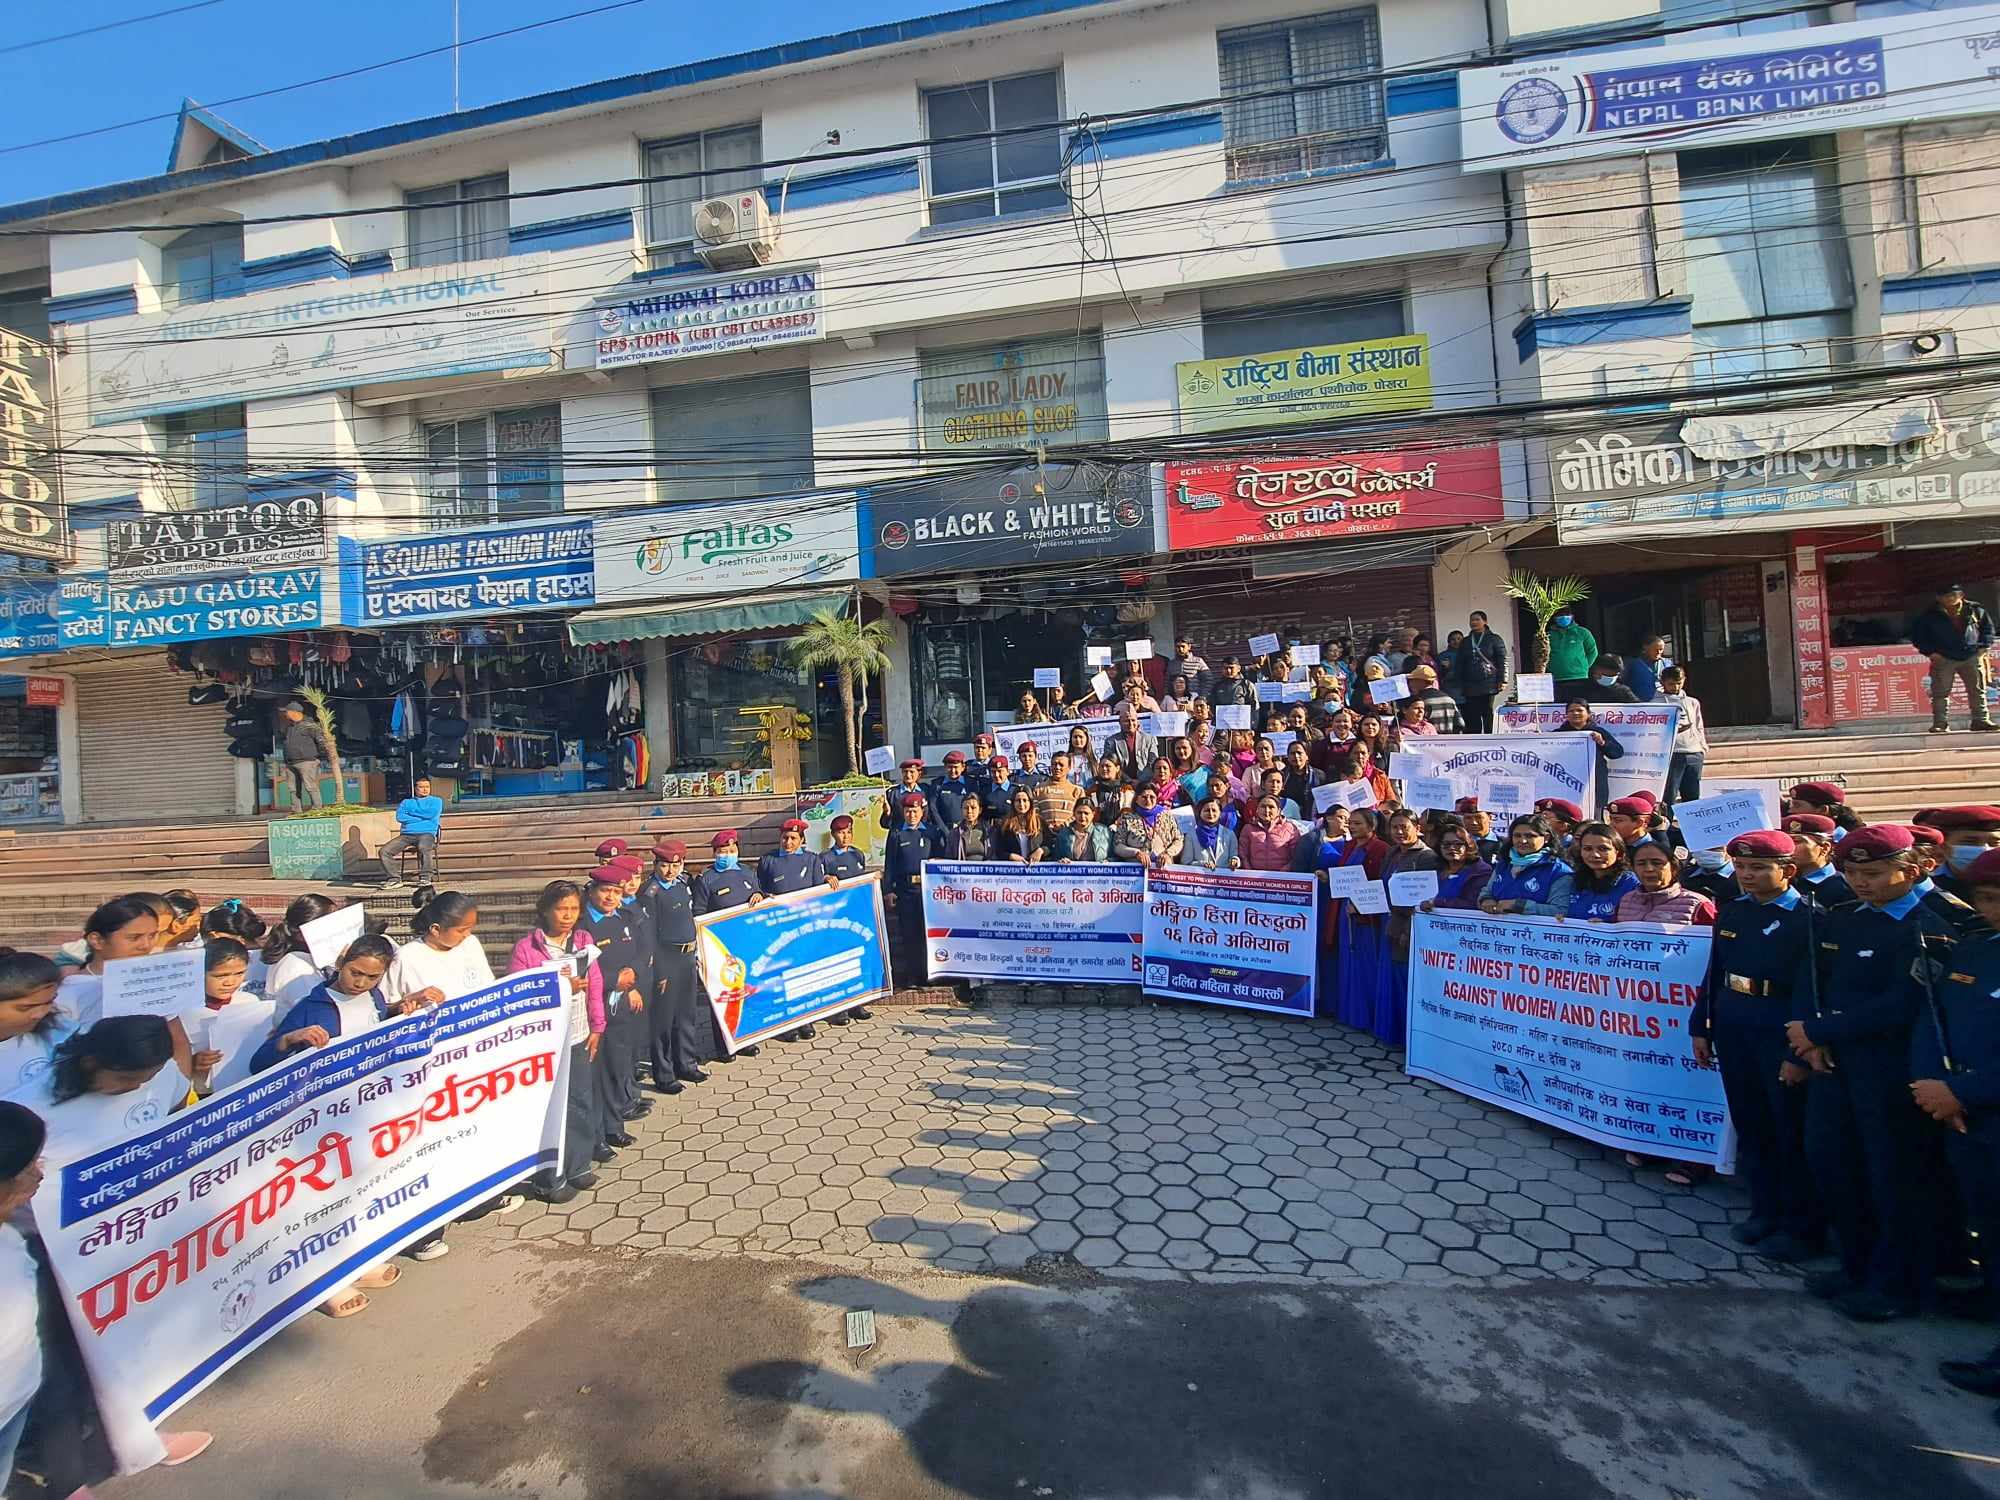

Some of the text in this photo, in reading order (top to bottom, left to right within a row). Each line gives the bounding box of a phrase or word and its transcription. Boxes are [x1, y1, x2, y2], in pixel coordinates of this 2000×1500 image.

[1605, 104, 1684, 128] NEPAL
[1697, 94, 1764, 118] BANK
[1776, 81, 1881, 108] LIMITED
[274, 271, 505, 322] INTERNATIONAL
[629, 273, 816, 317] NATIONAL KOREAN
[629, 295, 817, 333] LANGUAGE INSTITUTE
[751, 312, 816, 332] CLASSES)
[649, 343, 714, 360] RAJEEV GURUNG
[1222, 344, 1422, 390] राष्ट्रिय बीमा संस्थान
[954, 372, 1067, 409] FAIR LADY
[943, 404, 1077, 444] CLOTHING SHOP
[119, 497, 318, 549] TATTOO
[914, 499, 1111, 541] BLACK & WHITE
[1023, 524, 1112, 541] FASHION WORLD
[1266, 499, 1401, 531] सुन पसल
[142, 533, 283, 565] SUPPLIES
[366, 530, 546, 578] A SQUARE FASHION
[718, 557, 743, 569] Fresh
[745, 554, 769, 566] Fruit
[770, 551, 788, 563] and
[789, 549, 814, 563] Juice
[112, 571, 320, 614] RAJU GAURAV
[366, 592, 383, 618] ए
[63, 614, 105, 639] स्टोर्स
[114, 600, 319, 641] FANCY STORES
[1442, 746, 1506, 774] अधिकारको
[1511, 750, 1541, 770] लागि
[1543, 760, 1584, 794] महिला
[281, 822, 335, 839] SQUARE
[961, 865, 983, 874] INVEST
[985, 865, 995, 874] TO
[995, 865, 1024, 874] PREVENT
[1025, 866, 1057, 875] VIOLENCE
[1058, 866, 1086, 875] AGAINST
[1087, 866, 1114, 875] WOMEN
[971, 886, 998, 905] हिंसा
[1050, 890, 1067, 906] १६
[1071, 888, 1095, 905] दिने
[1203, 904, 1240, 926] हिंसा
[1163, 926, 1291, 955] १६ दिने अभियान
[1494, 939, 1662, 974] हिंसा १६ दिने अभियान
[1543, 930, 1571, 945] मानव
[1573, 932, 1620, 950] गरिमाको
[1623, 937, 1654, 953] रक्षा
[1171, 974, 1285, 1001] दलित महिला संघ कास्की
[1466, 954, 1514, 983] INVEST
[1518, 962, 1541, 986] TO
[1545, 966, 1611, 998] PREVENT
[1613, 974, 1704, 1008] VIOLEN
[1442, 979, 1662, 1041] AGAINST WOMEN AND GIRLS
[165, 1124, 194, 1145] नारा
[247, 1076, 291, 1105] INVEST
[292, 1066, 308, 1082] TO
[309, 1043, 362, 1074] PREVENT
[364, 1022, 418, 1051] VIOLENCE
[458, 989, 502, 1012] WOMEN
[502, 987, 512, 998] &
[513, 978, 551, 994] GIRLS"
[141, 1159, 175, 1182] नारा
[226, 1117, 254, 1142] हिंसा
[357, 1051, 387, 1073] महिला
[189, 1157, 242, 1203] हिंसा
[325, 1097, 352, 1121] १६
[357, 1074, 394, 1107] दिने
[474, 1018, 554, 1054] कार्यक्रम
[368, 1050, 557, 1160] कार्यक्रम
[1624, 1098, 1652, 1116] सेवा
[1657, 1101, 1689, 1122] केन्द्र
[1668, 1123, 1717, 1146] पोखरा
